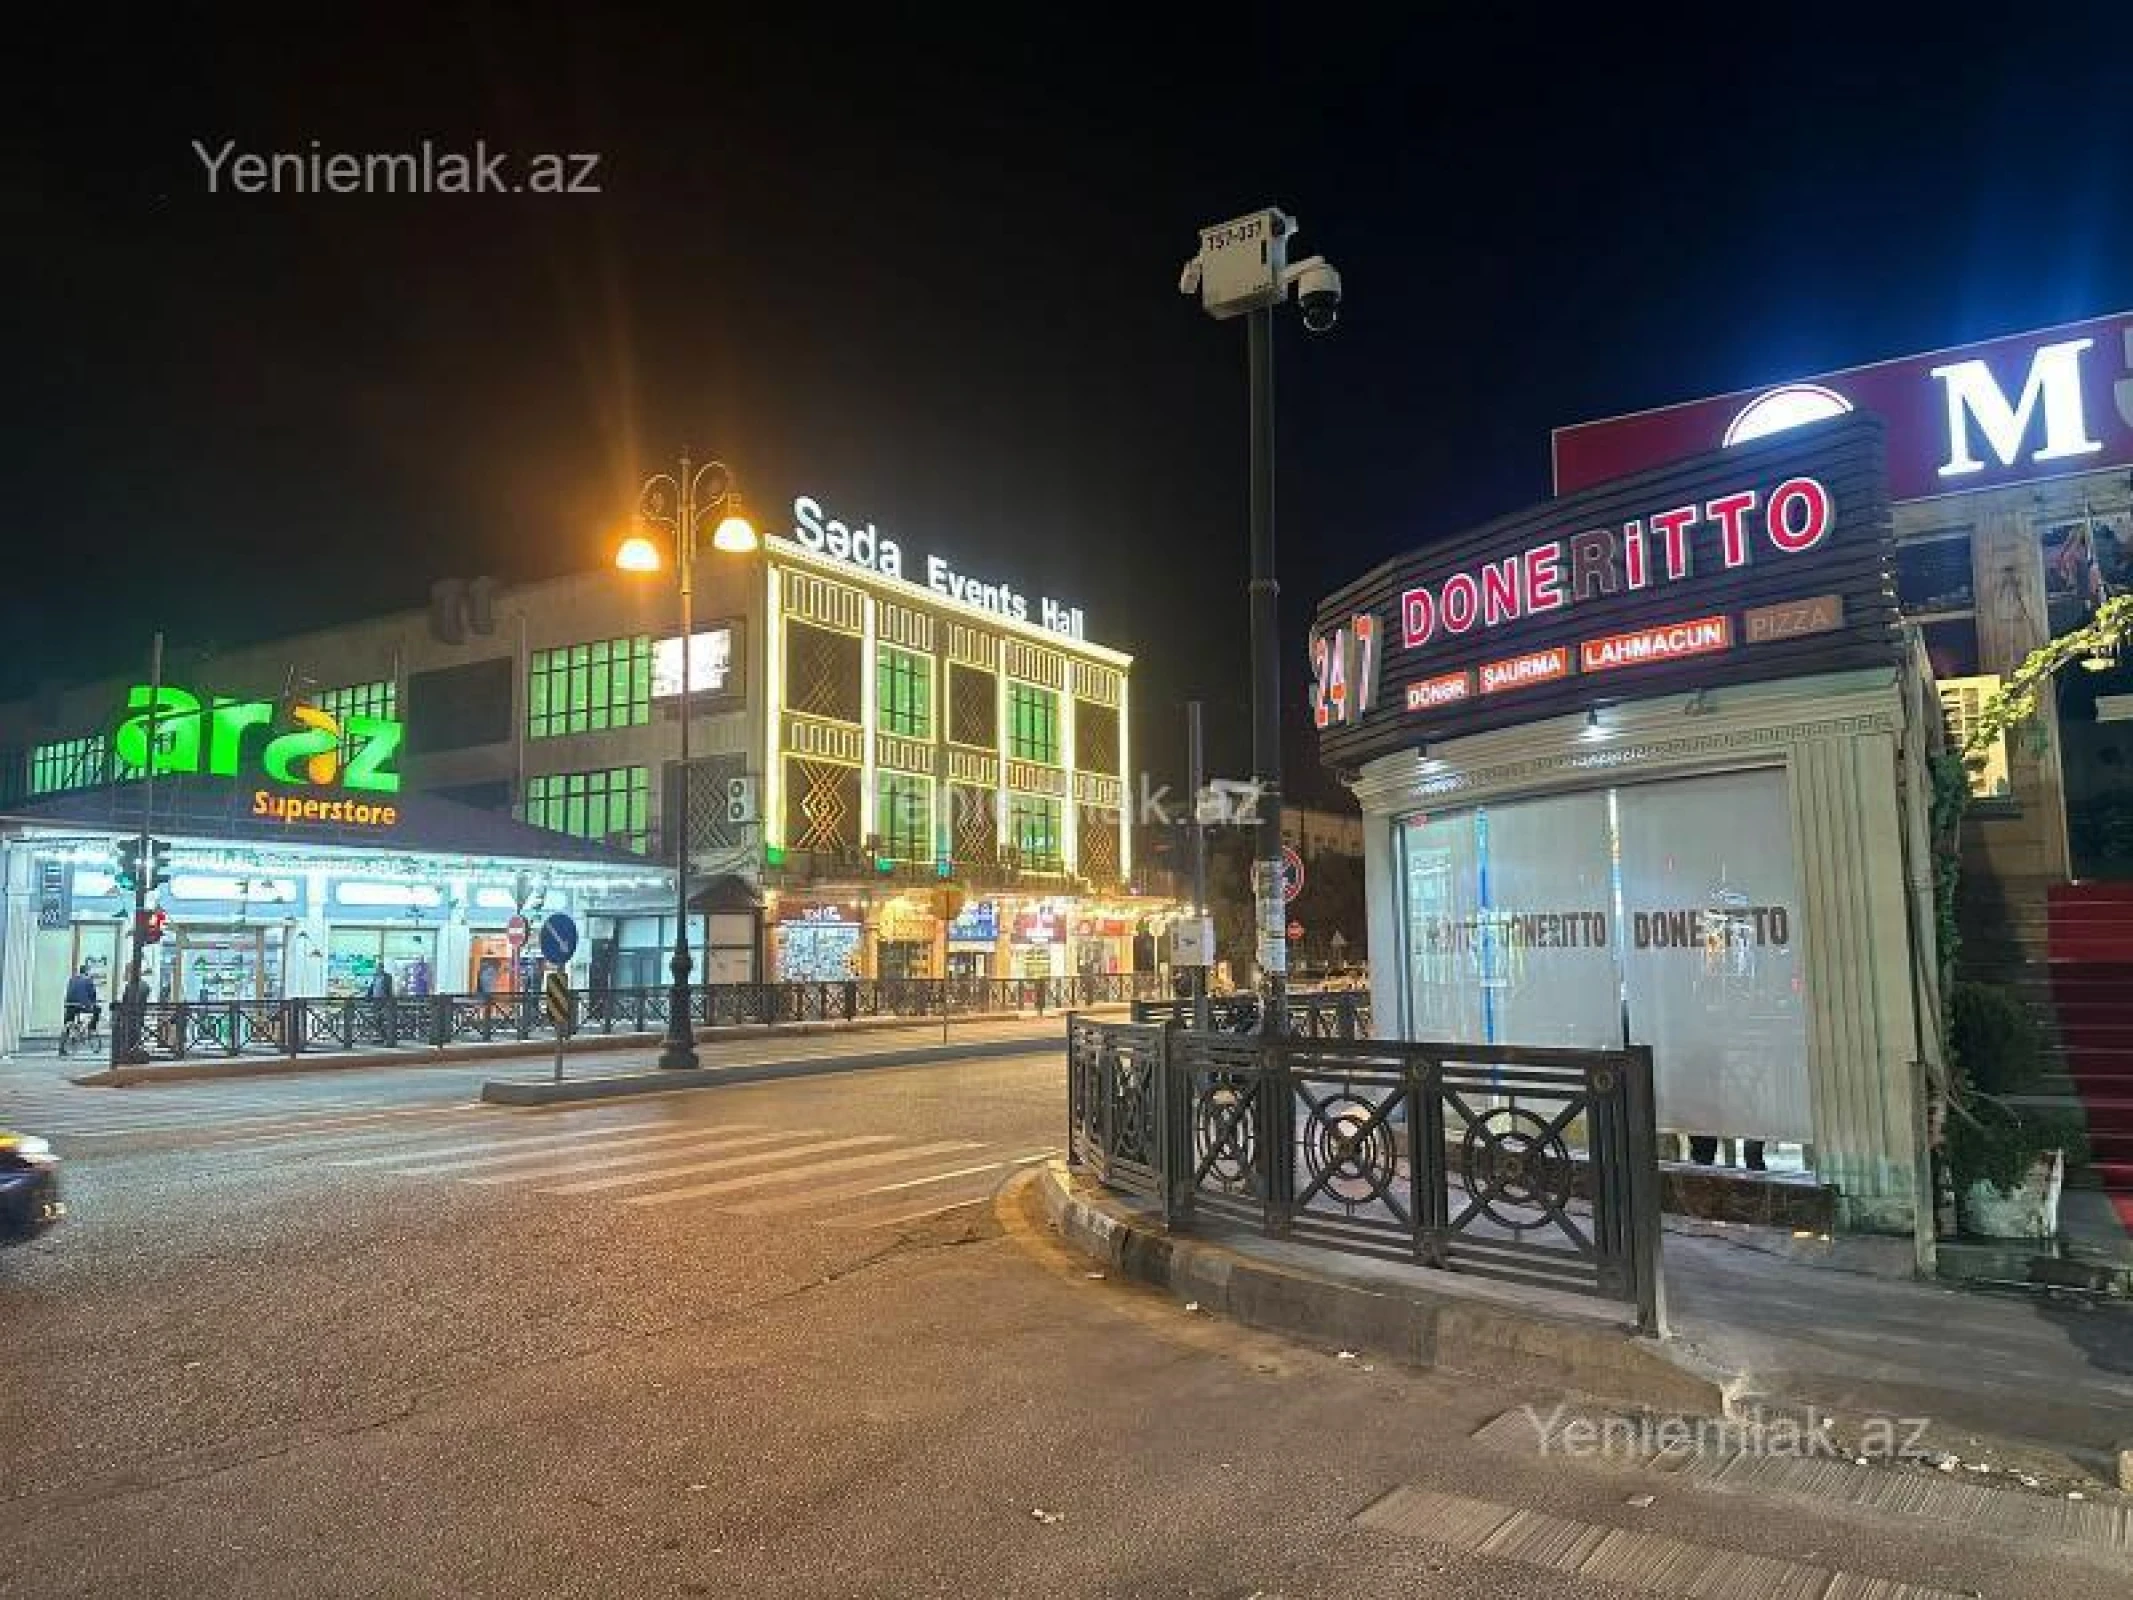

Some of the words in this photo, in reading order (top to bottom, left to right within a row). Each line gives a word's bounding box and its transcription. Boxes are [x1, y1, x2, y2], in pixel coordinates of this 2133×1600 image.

[927, 553, 1028, 621] Events
[1041, 596, 1084, 641] Hall
[1584, 622, 1724, 667] LAHMACUN
[116, 684, 403, 793] araz
[252, 789, 397, 826] Superstore
